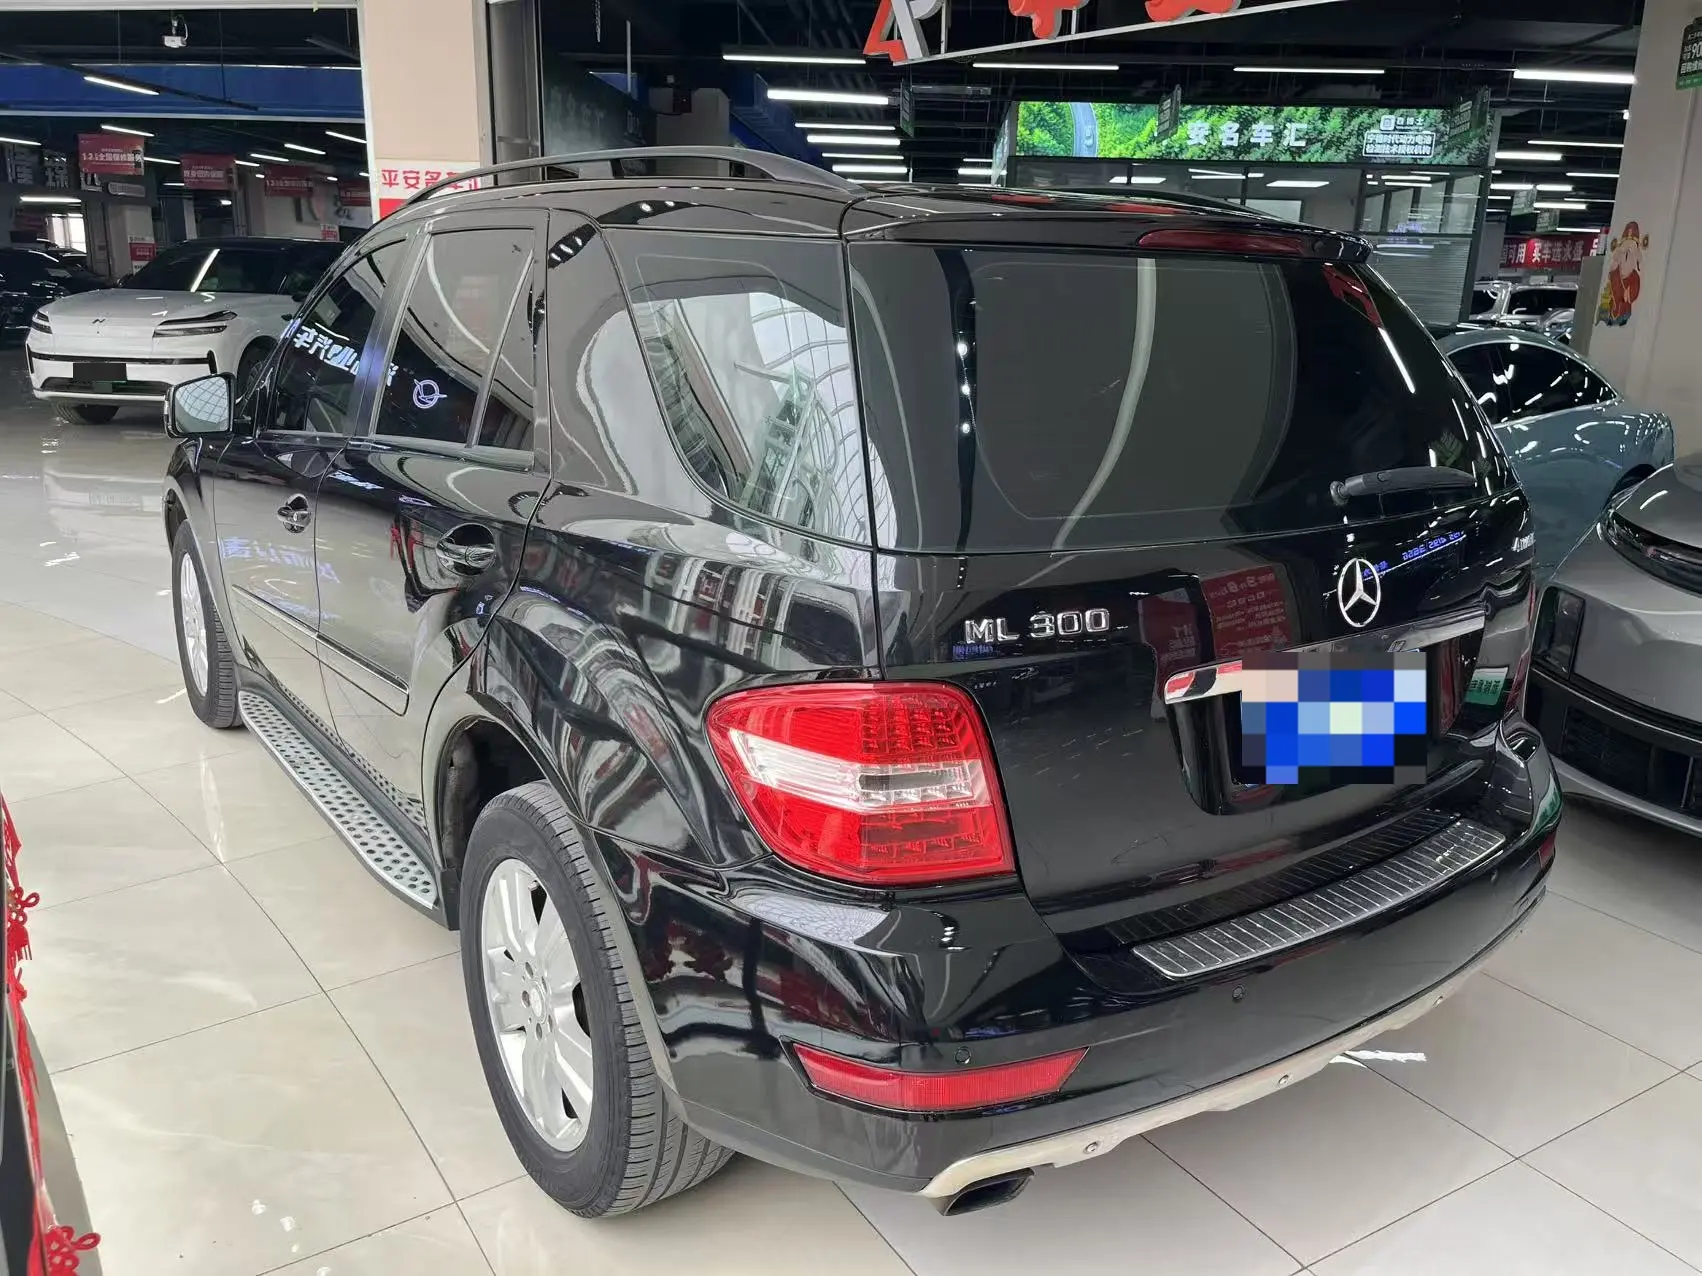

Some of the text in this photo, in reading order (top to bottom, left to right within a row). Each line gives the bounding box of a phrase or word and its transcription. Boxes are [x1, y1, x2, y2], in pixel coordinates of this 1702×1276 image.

[1155, 120, 1308, 147] 安名车汇
[964, 607, 1110, 644] ML 300
